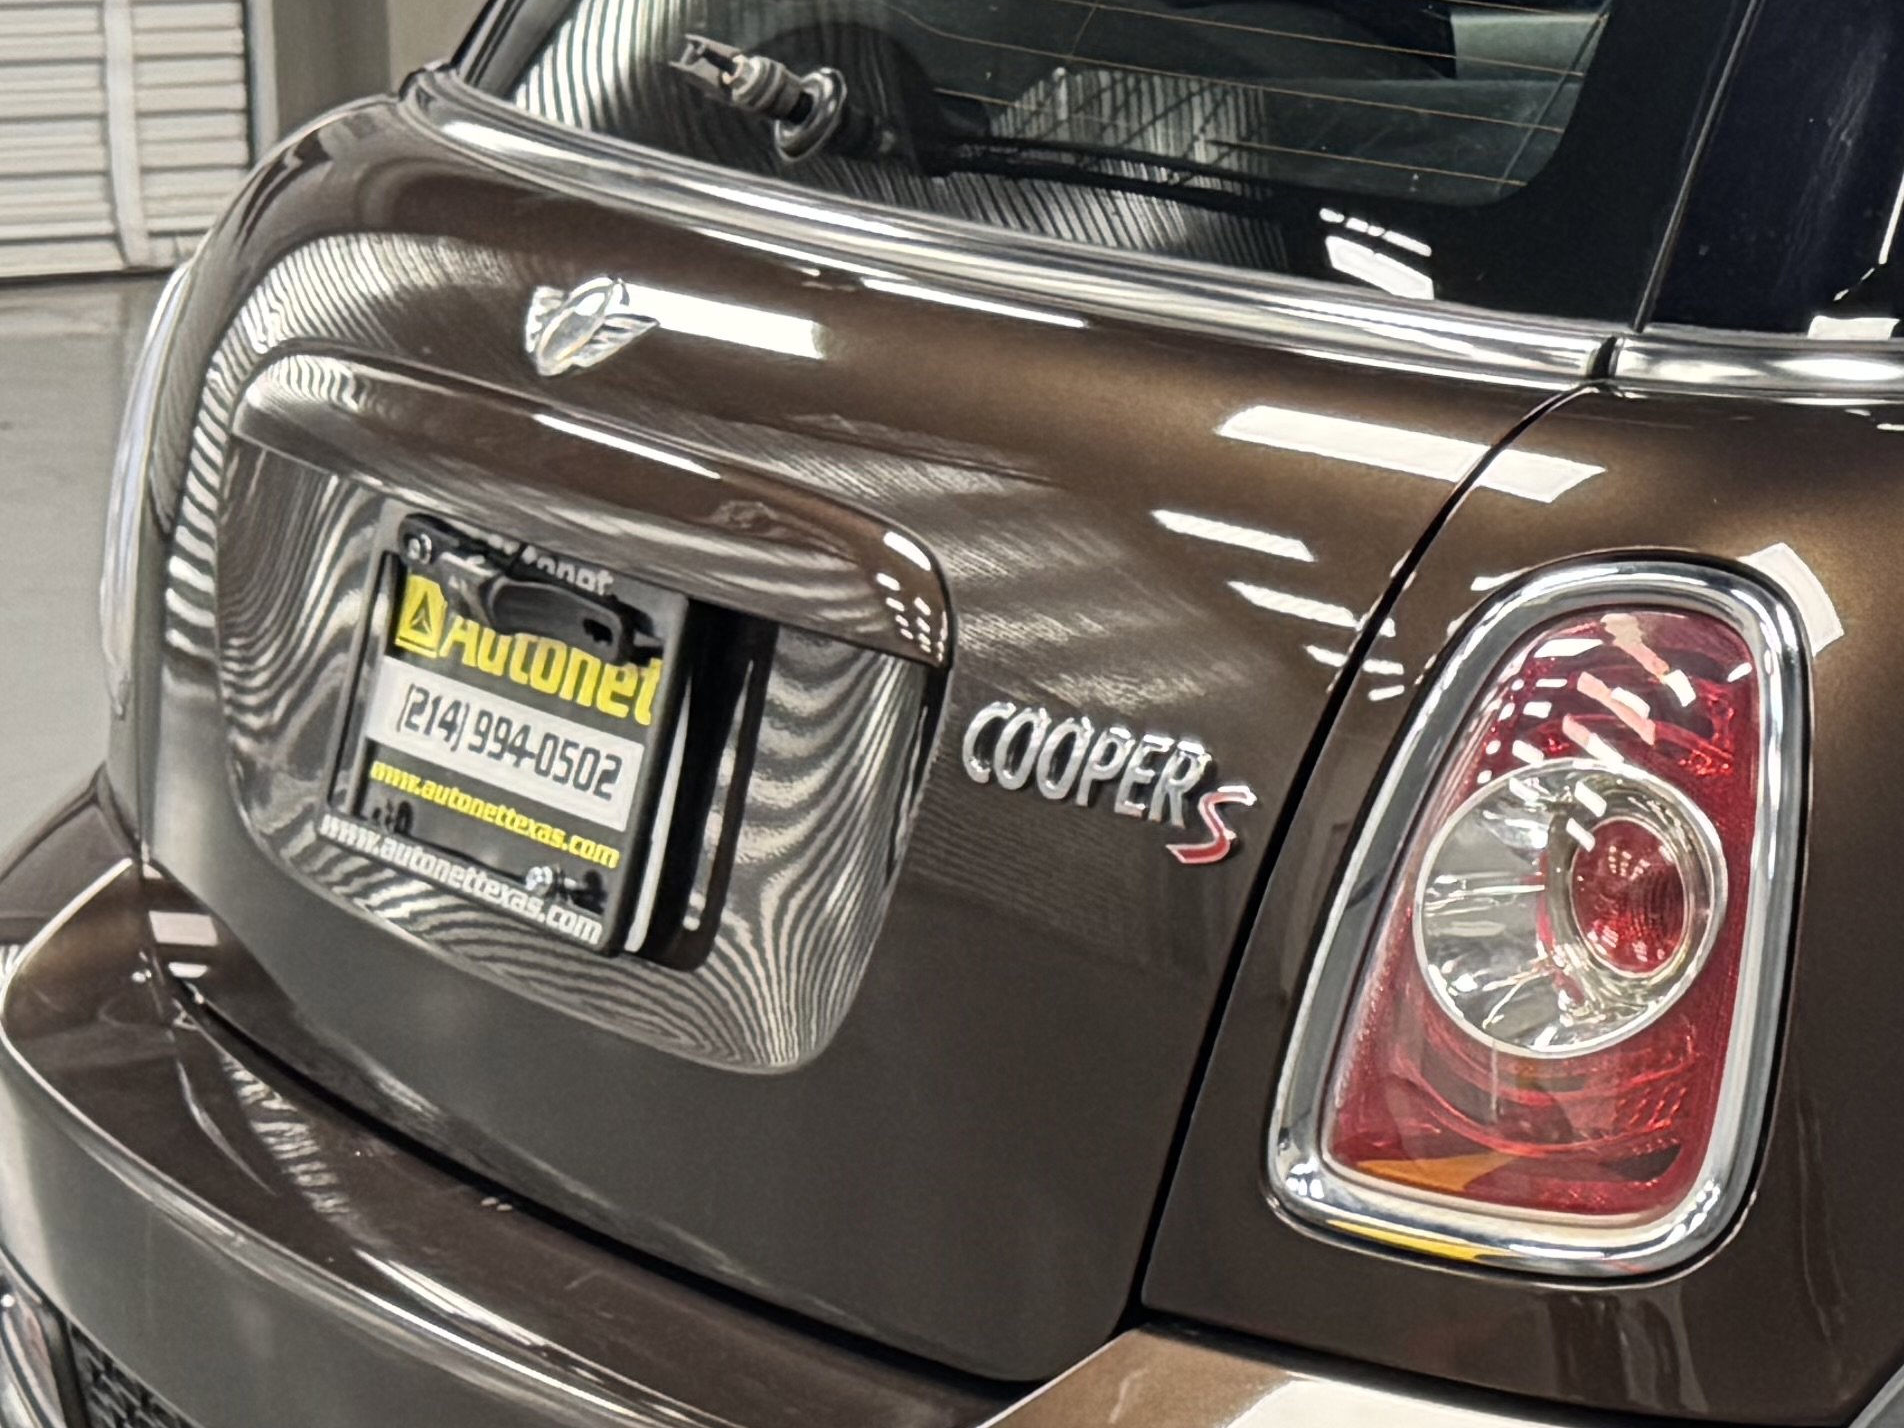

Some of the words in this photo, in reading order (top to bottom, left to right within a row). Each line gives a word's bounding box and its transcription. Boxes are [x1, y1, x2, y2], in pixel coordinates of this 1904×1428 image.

[397, 683, 470, 753] (214)
[468, 710, 623, 802] 994-0502
[962, 701, 1212, 829] COOPER
[1165, 785, 1257, 864] S
[370, 760, 620, 869] www.autonettexas.com
[319, 813, 603, 945] www.autonettexas.com
